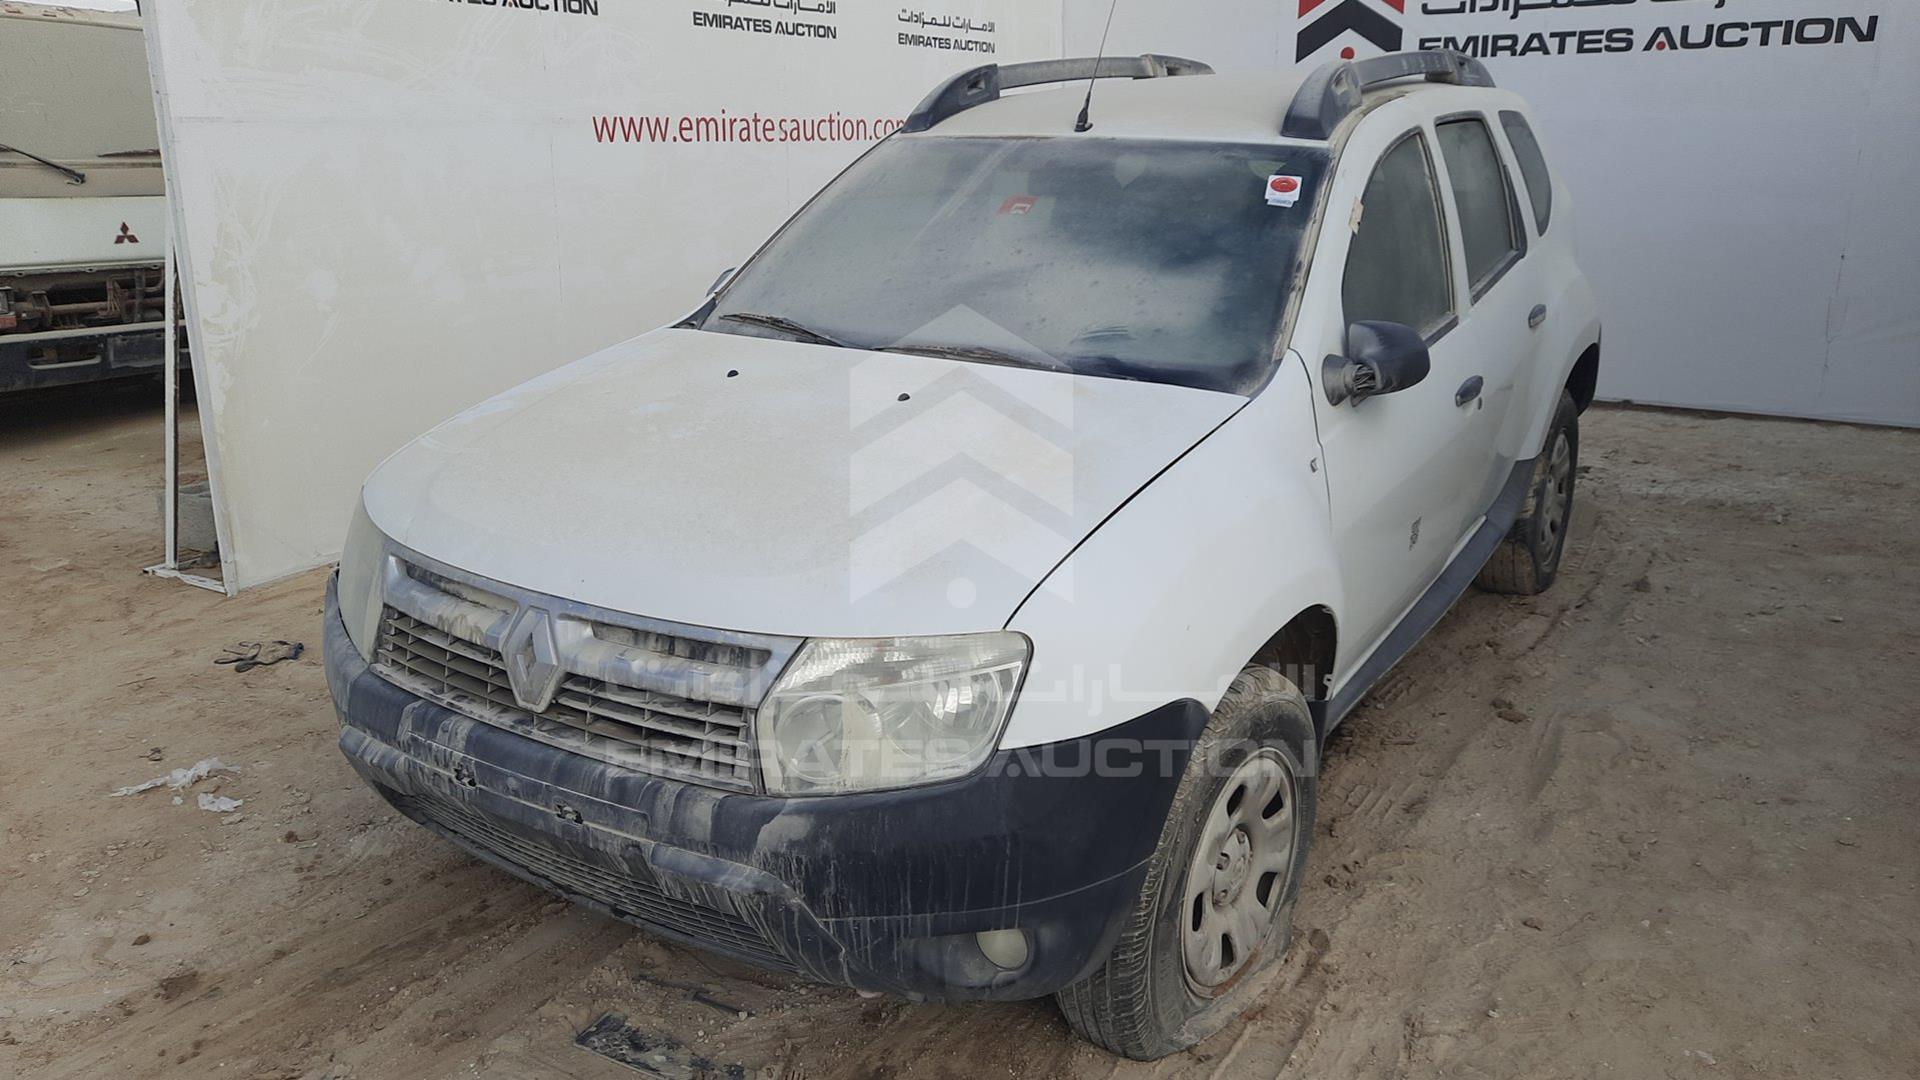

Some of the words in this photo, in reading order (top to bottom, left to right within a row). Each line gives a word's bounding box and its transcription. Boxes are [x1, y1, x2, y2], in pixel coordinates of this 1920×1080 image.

[693, 11, 772, 34] EMIRATES
[775, 21, 837, 39] AUCTION
[1419, 28, 1634, 58] EMIRATES
[1642, 15, 1878, 51] AUCTION
[898, 32, 951, 50] EMIRATES
[953, 39, 995, 53] AUCTION
[592, 109, 906, 143] www.emiratesauction.co
